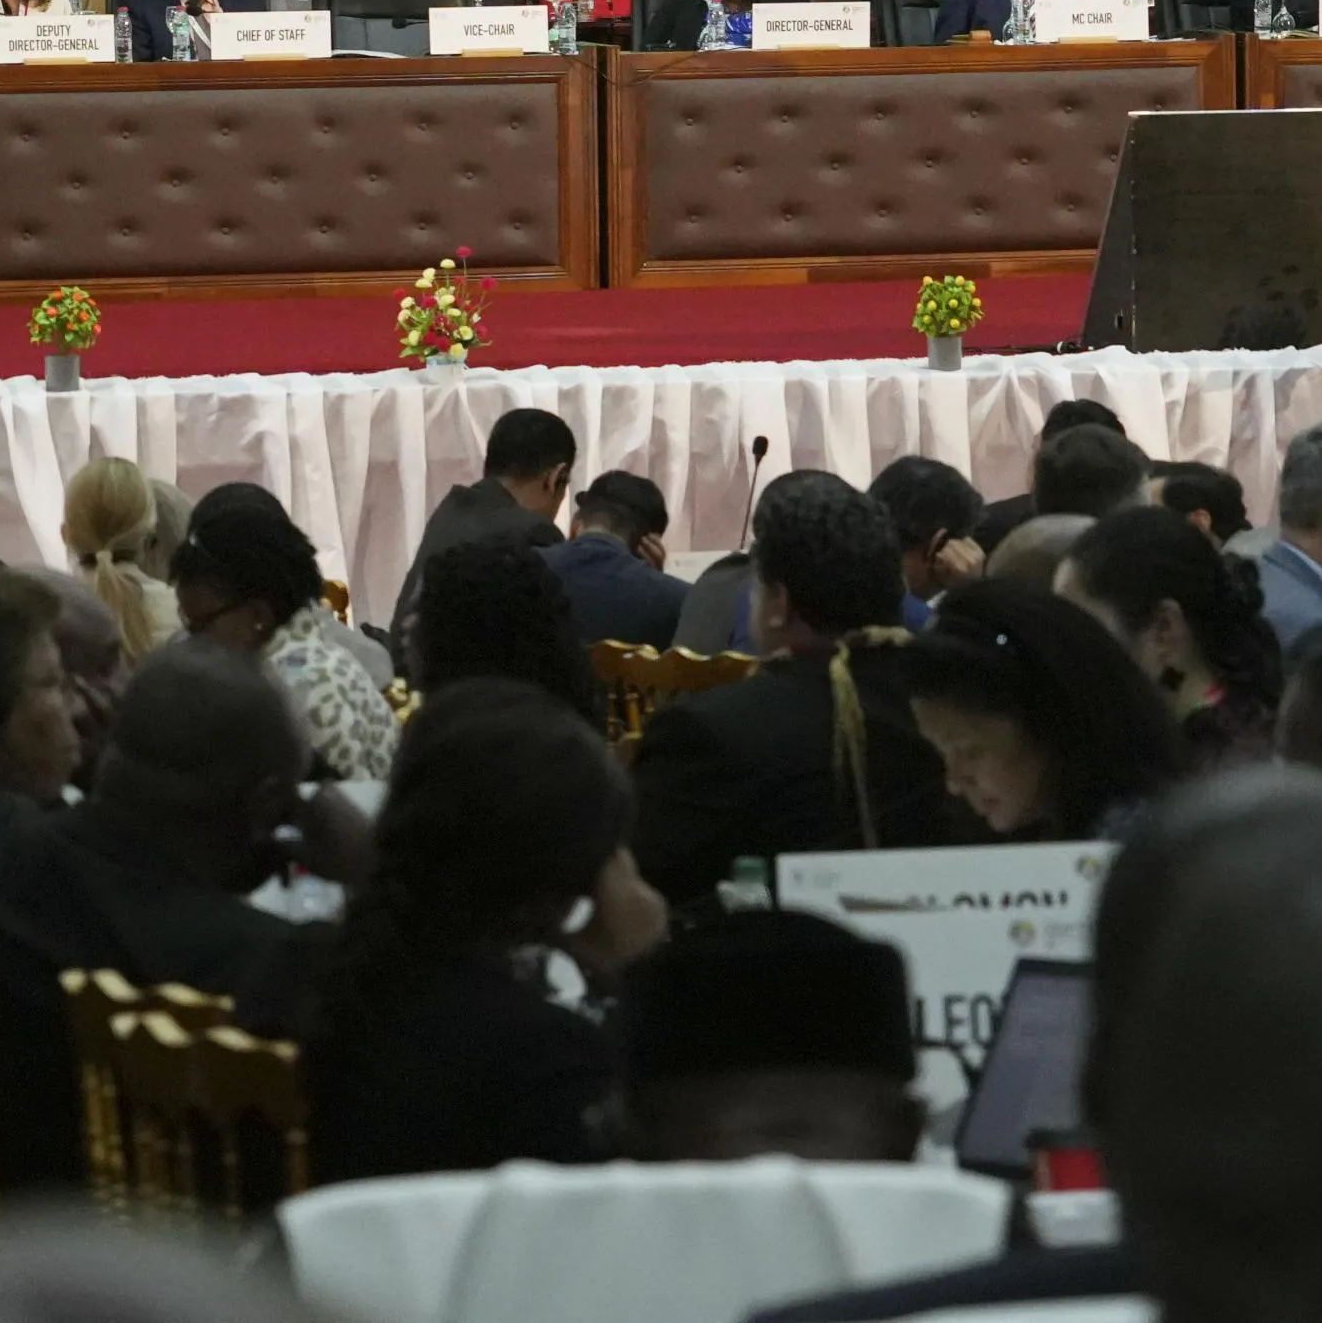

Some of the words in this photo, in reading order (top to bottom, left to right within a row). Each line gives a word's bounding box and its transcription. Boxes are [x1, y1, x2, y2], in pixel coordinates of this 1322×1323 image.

[1072, 14, 1084, 24] MC
[1087, 11, 1113, 25] CHAIR
[464, 24, 514, 36] VICE-CHAIR
[767, 20, 853, 31] DIRECTOR-GENERAL
[37, 25, 71, 40] DEPUTY
[237, 30, 261, 41] CHIEF
[265, 30, 275, 41] OF
[279, 29, 305, 40] STAFF
[9, 39, 99, 51] DIRECTOR-GENERAL
